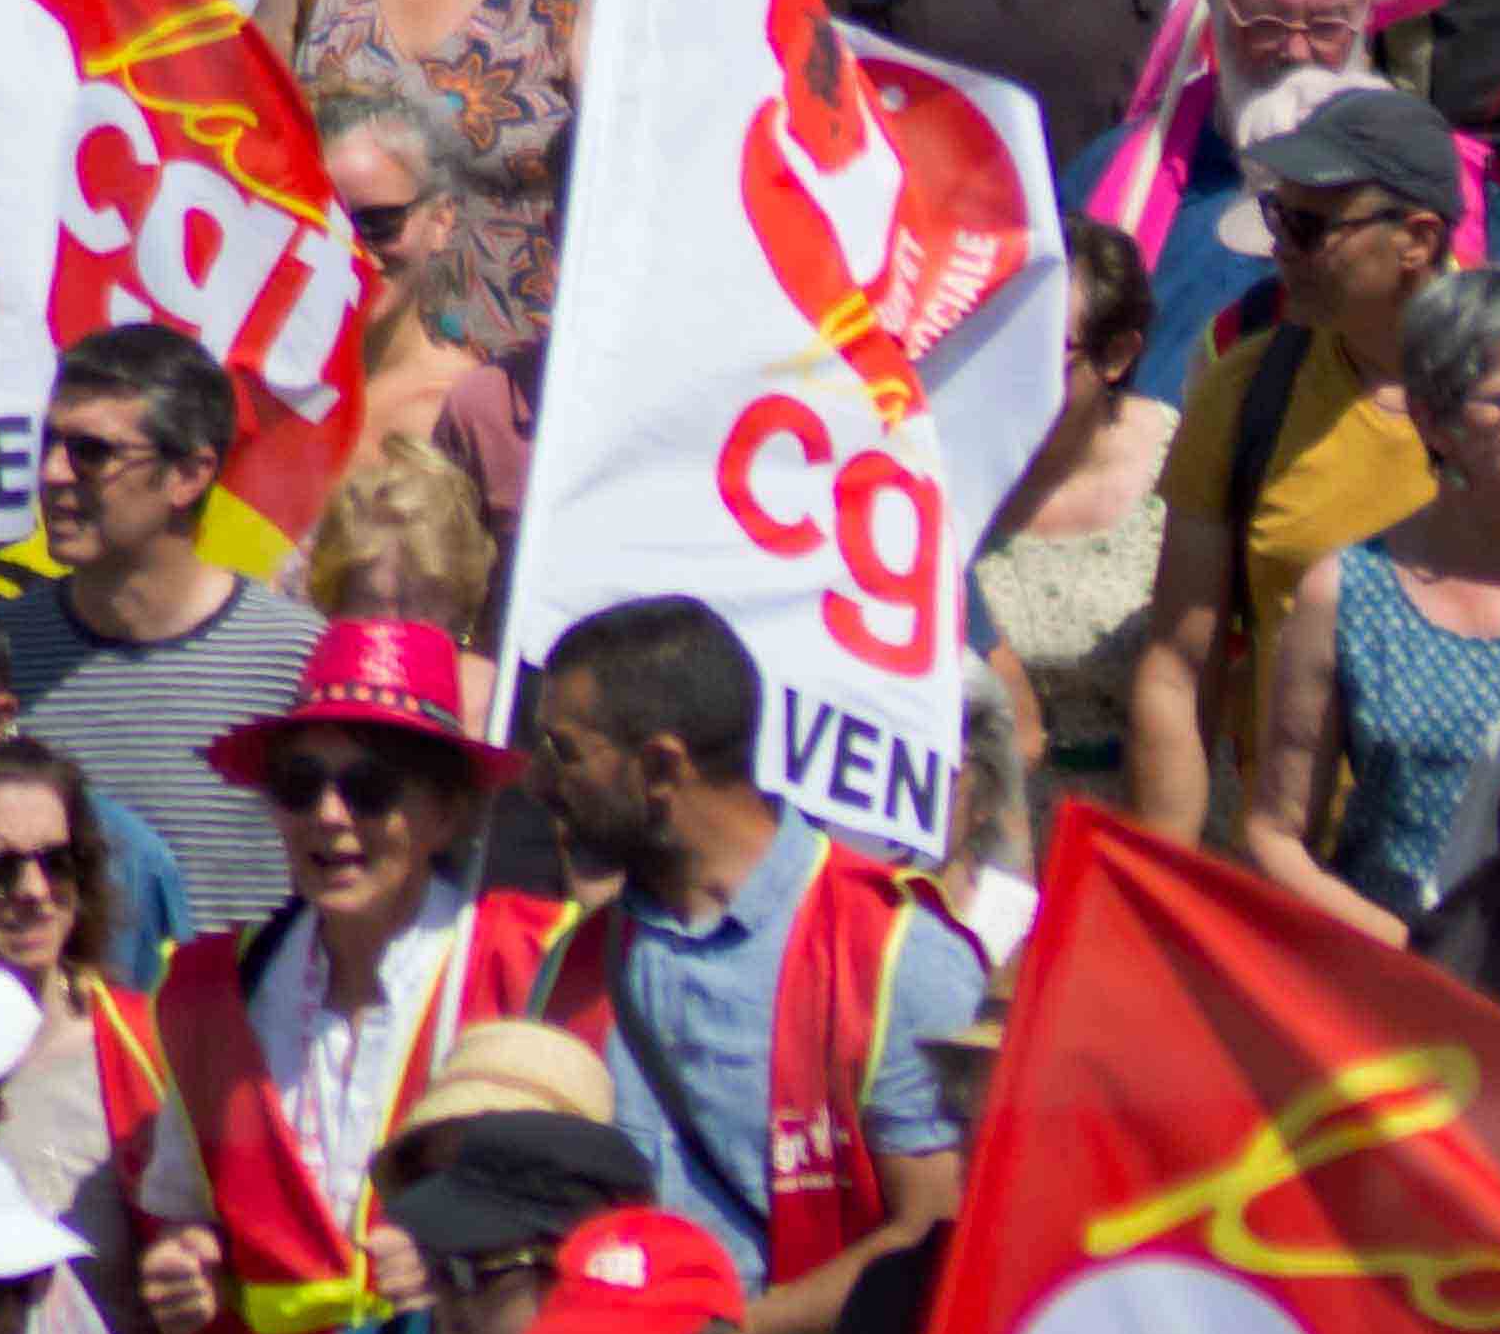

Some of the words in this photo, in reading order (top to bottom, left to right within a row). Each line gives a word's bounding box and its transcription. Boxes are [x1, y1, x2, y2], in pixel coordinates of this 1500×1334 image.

[59, 82, 372, 425] cgt
[717, 391, 948, 678] cg
[779, 685, 944, 837] VEN
